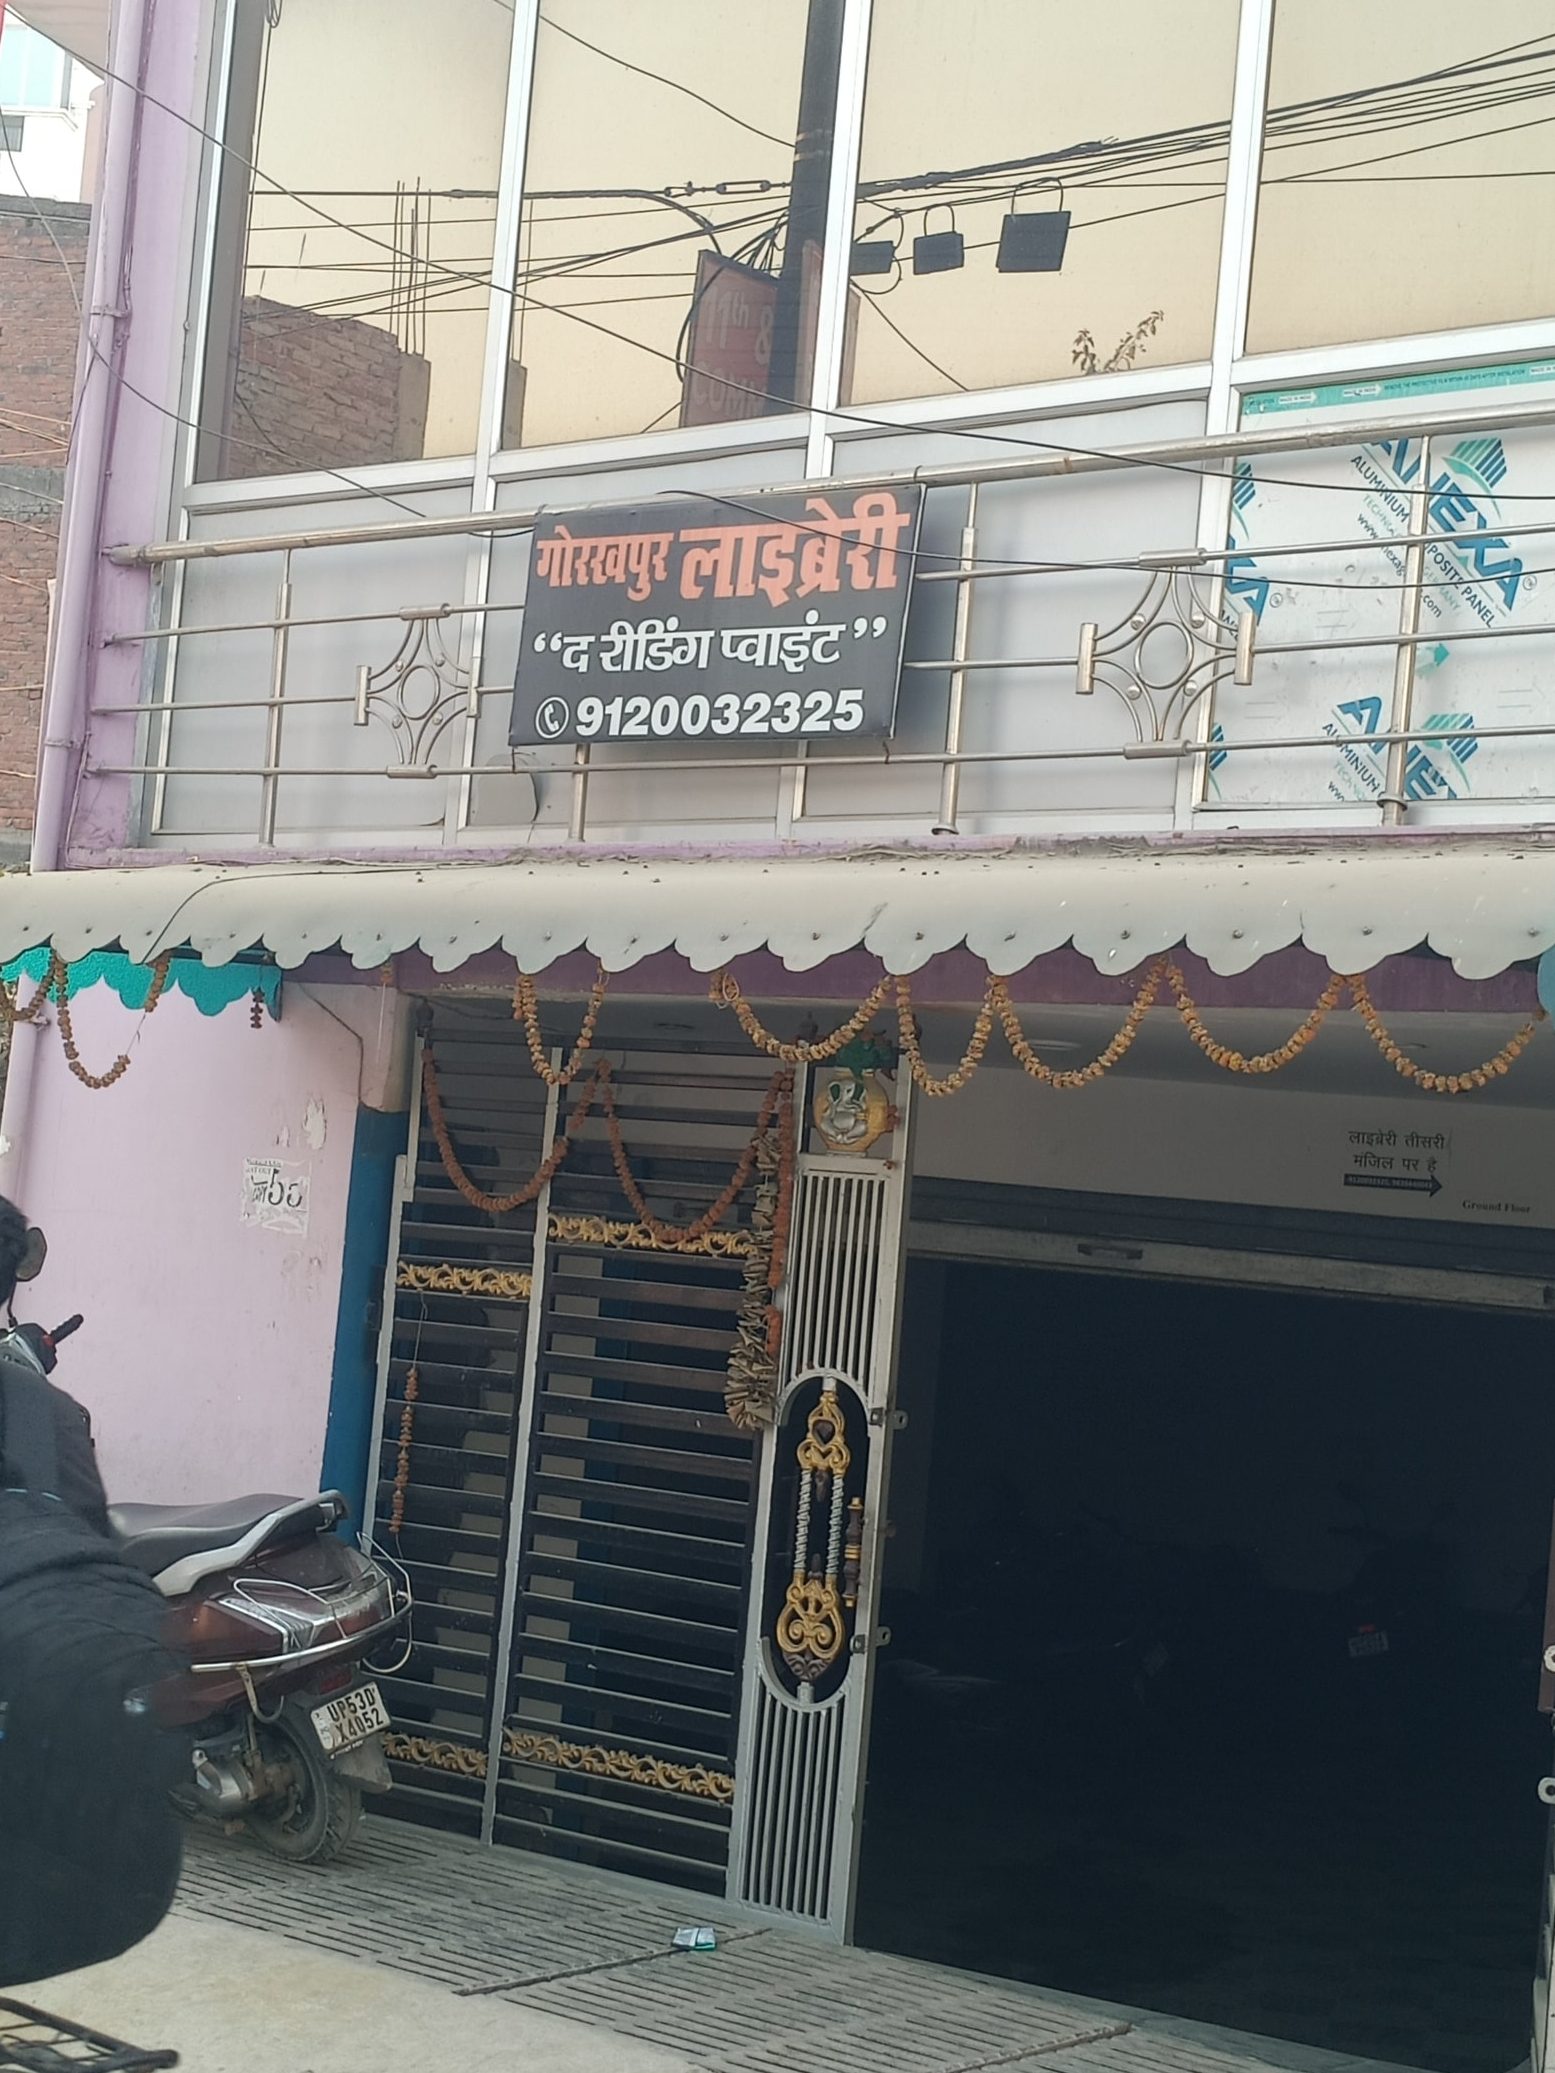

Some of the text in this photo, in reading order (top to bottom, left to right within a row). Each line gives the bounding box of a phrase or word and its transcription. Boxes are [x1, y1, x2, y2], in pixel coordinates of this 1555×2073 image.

[537, 492, 911, 608] गोरखपुर लाइब्रेरी
[1351, 455, 1410, 523] ALUMINIUM
[1461, 586, 1497, 629] PANEL
[599, 615, 716, 673] रीडिंग
[575, 688, 865, 738] 9120032325
[1402, 1158, 1420, 1172] पर
[1403, 1131, 1445, 1150] तीसरी
[326, 1687, 376, 1723] UP53D
